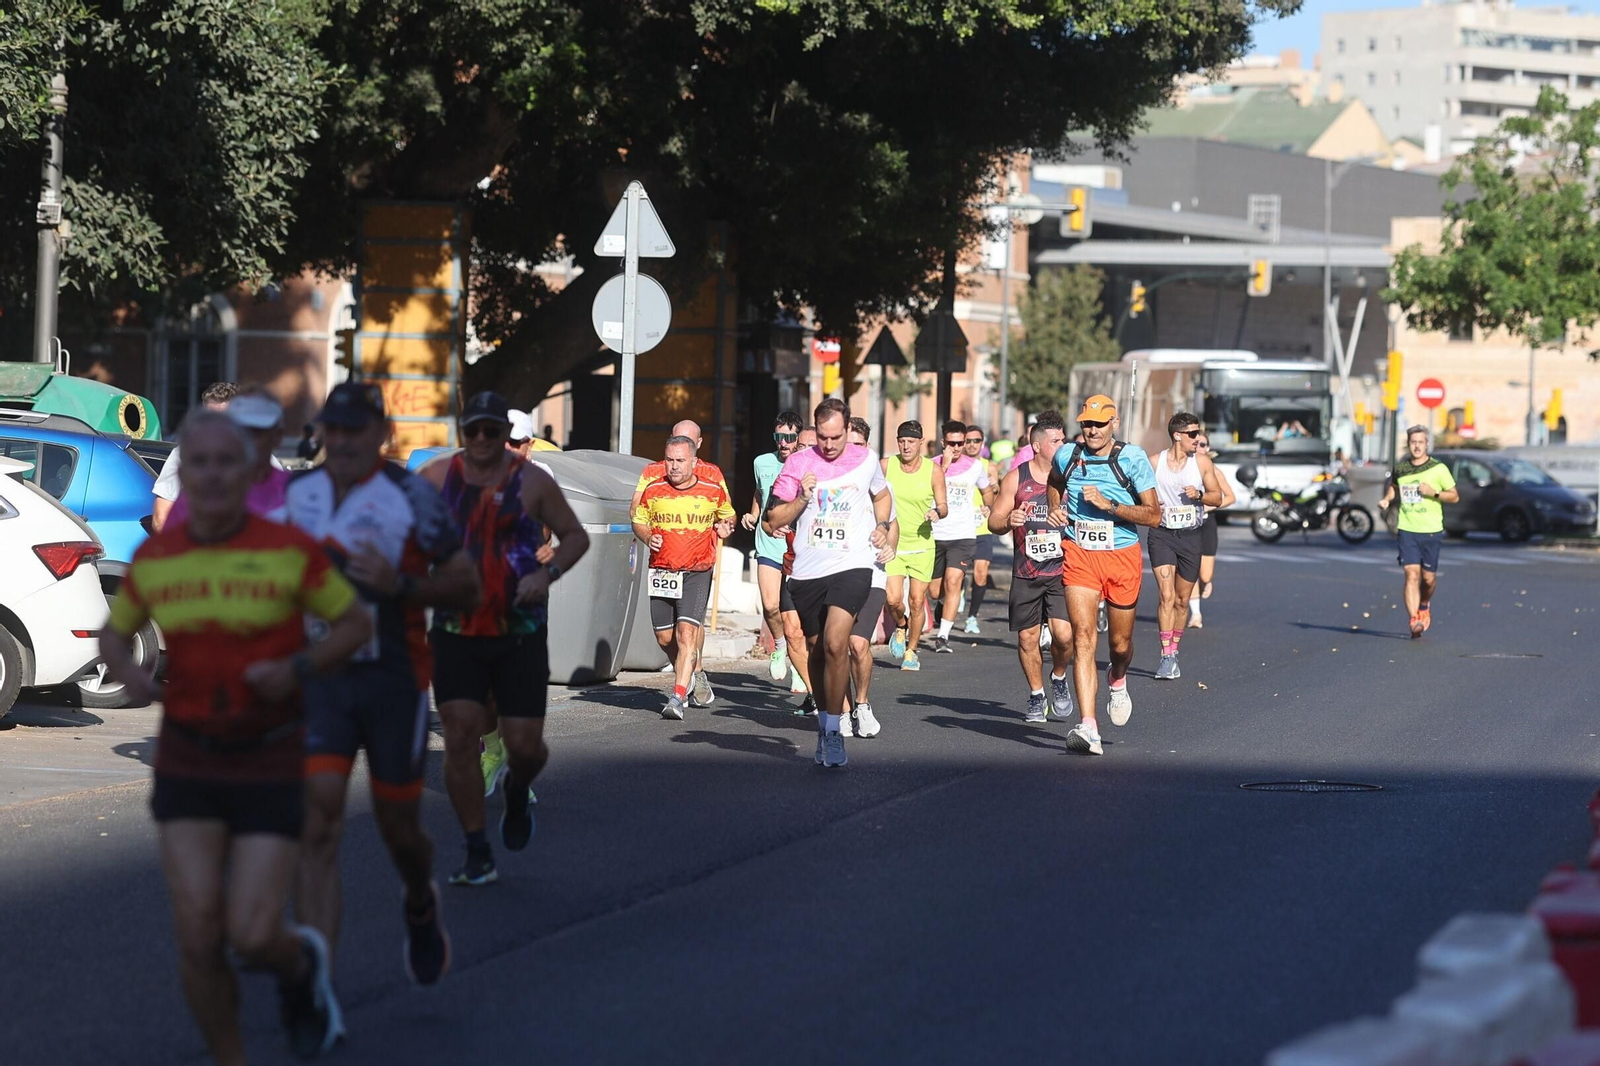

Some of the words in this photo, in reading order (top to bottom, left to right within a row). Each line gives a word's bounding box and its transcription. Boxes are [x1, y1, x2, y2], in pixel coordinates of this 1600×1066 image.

[949, 487, 967, 496] 735
[1171, 513, 1192, 522] 178
[813, 527, 845, 540] 419
[1079, 530, 1107, 541] 766
[1031, 542, 1057, 554] 563
[652, 578, 678, 590] 620
